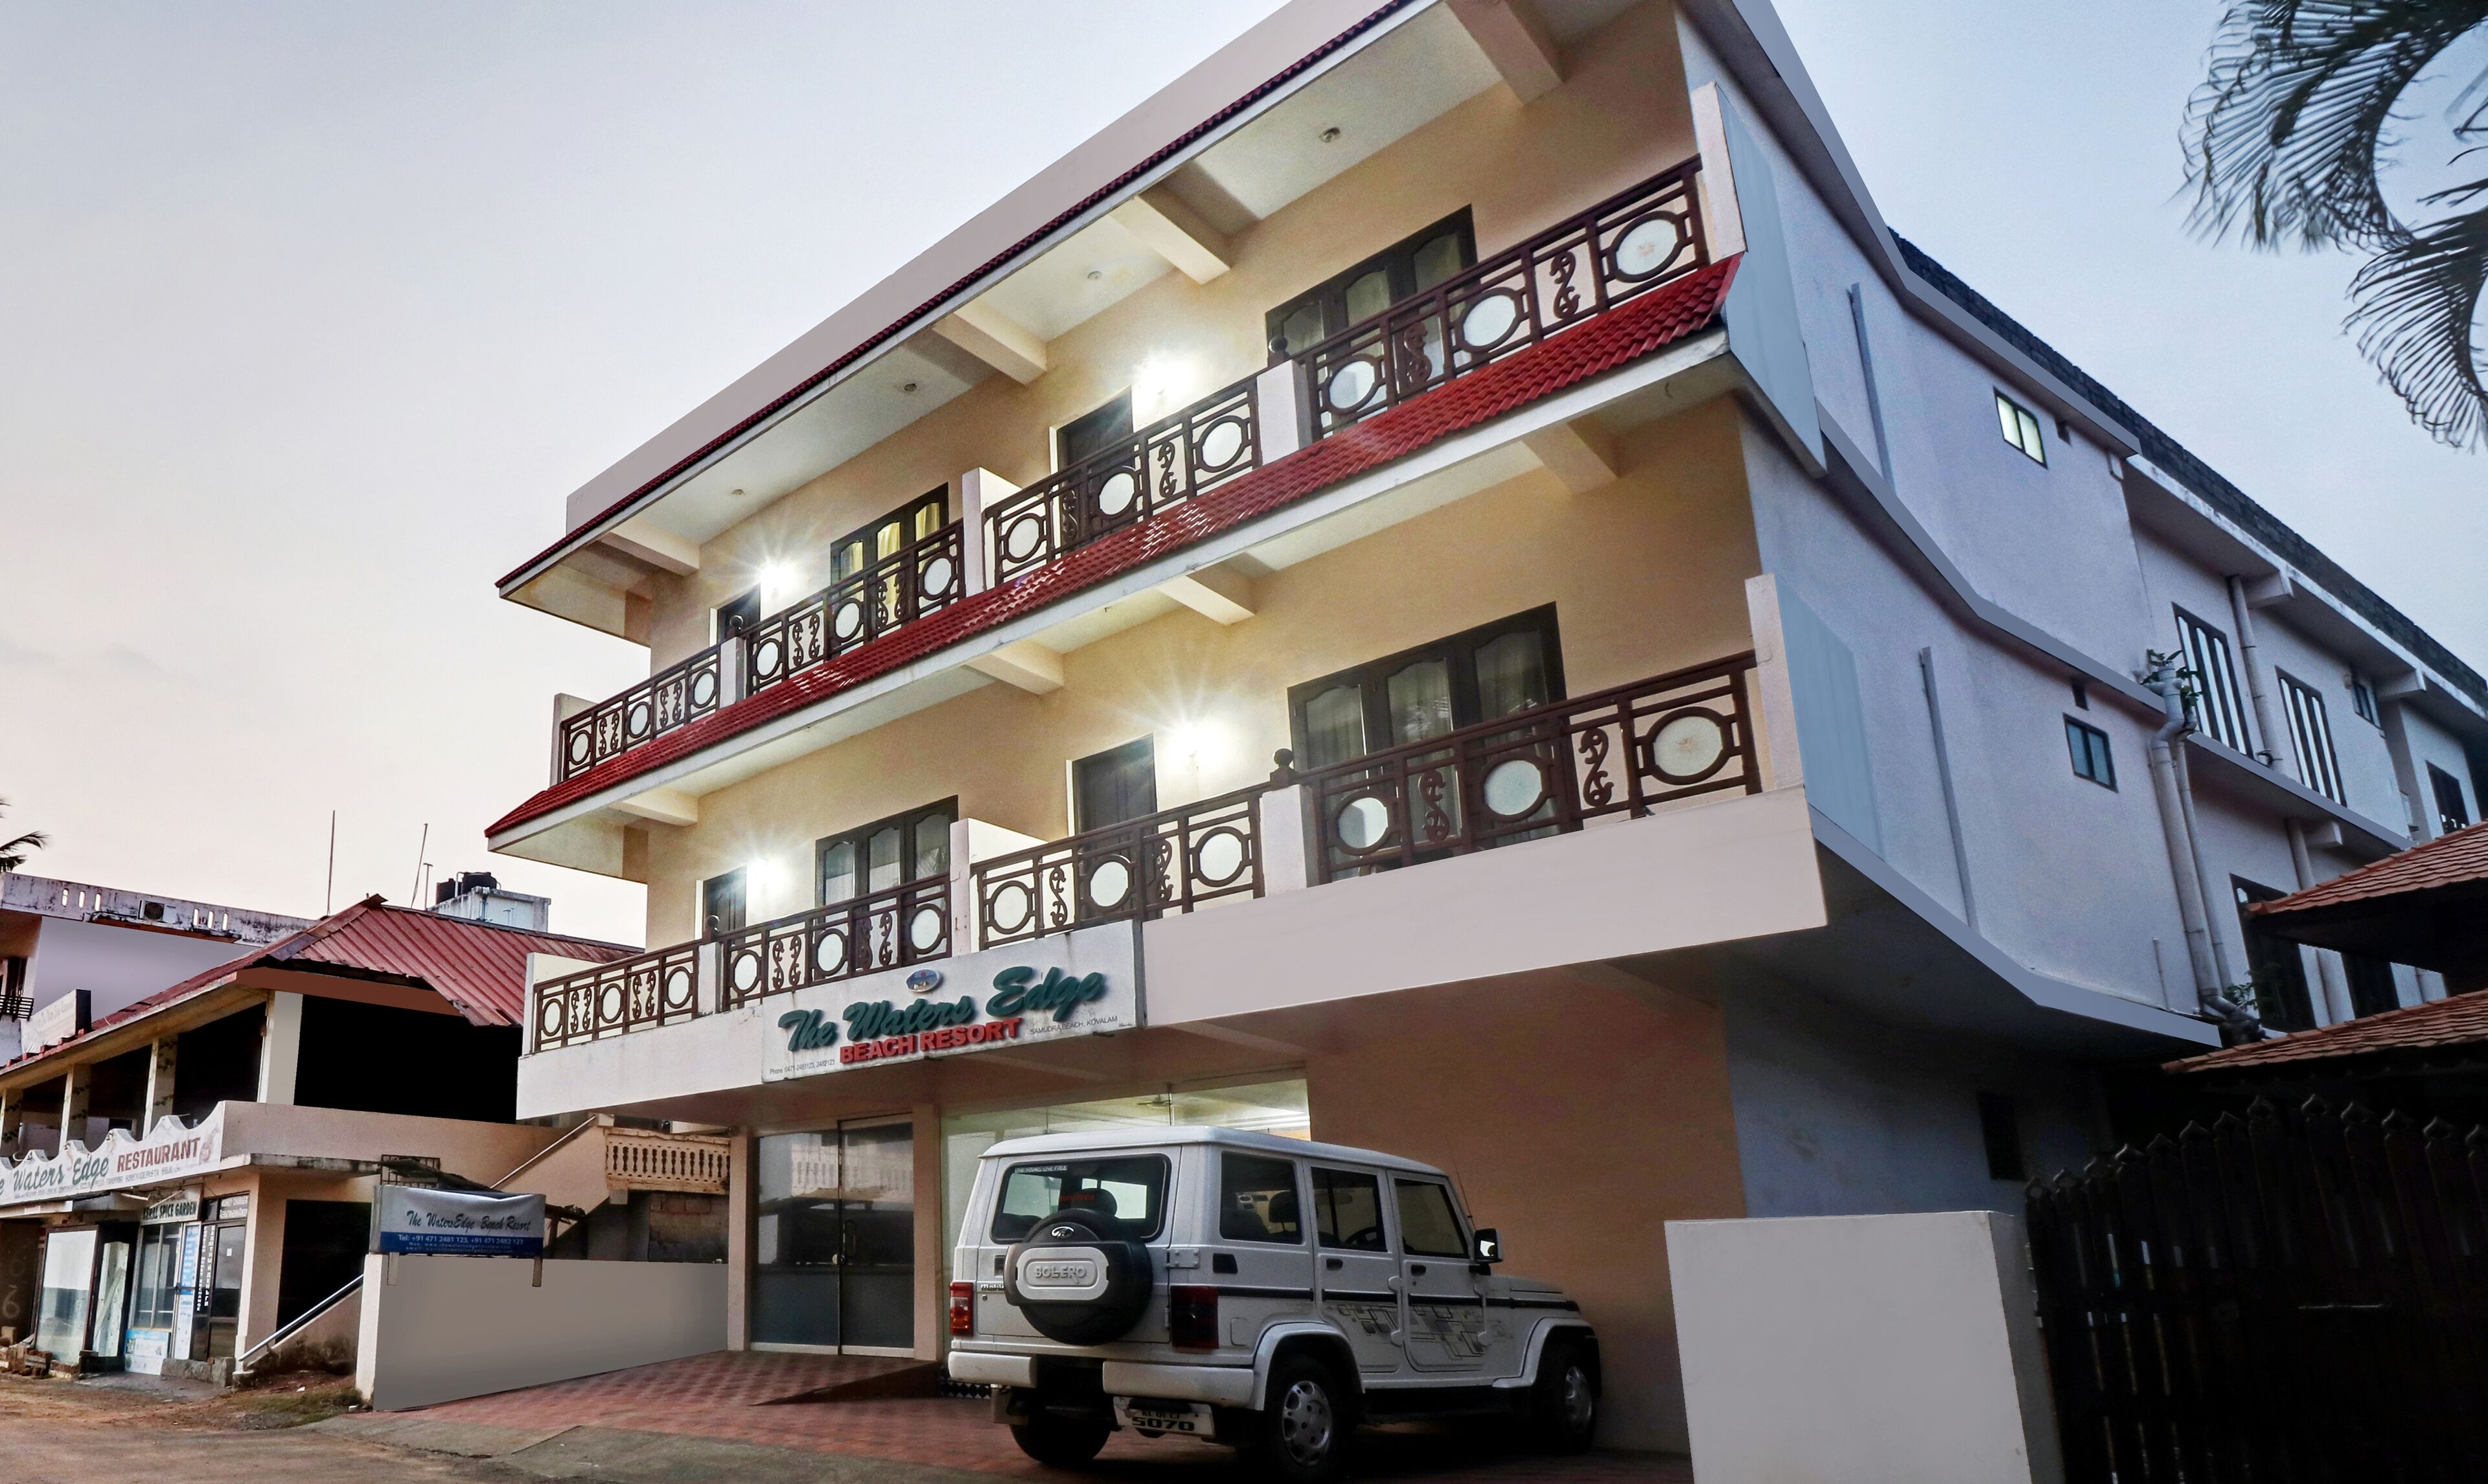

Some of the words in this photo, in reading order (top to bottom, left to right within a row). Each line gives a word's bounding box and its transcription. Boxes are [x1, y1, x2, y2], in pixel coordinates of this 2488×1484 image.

[778, 1009, 837, 1051] The
[842, 996, 974, 1041] Waters
[985, 966, 1104, 1022] Edge
[1030, 1023, 1062, 1035] SAMUDRA
[1087, 1016, 1118, 1026] KOVALAM
[840, 1035, 916, 1064] BEACH
[919, 1017, 1022, 1051] RESORT
[14, 1164, 65, 1193] Waters
[72, 1156, 109, 1190] Edge
[117, 1137, 202, 1173] RESTAURANT
[159, 1204, 174, 1219] SPICE
[175, 1202, 197, 1216] GARDEN
[406, 1210, 422, 1227] The
[507, 1215, 531, 1231] Resort
[1035, 1266, 1087, 1284] BOLERO
[1132, 1417, 1195, 1432] 5070
